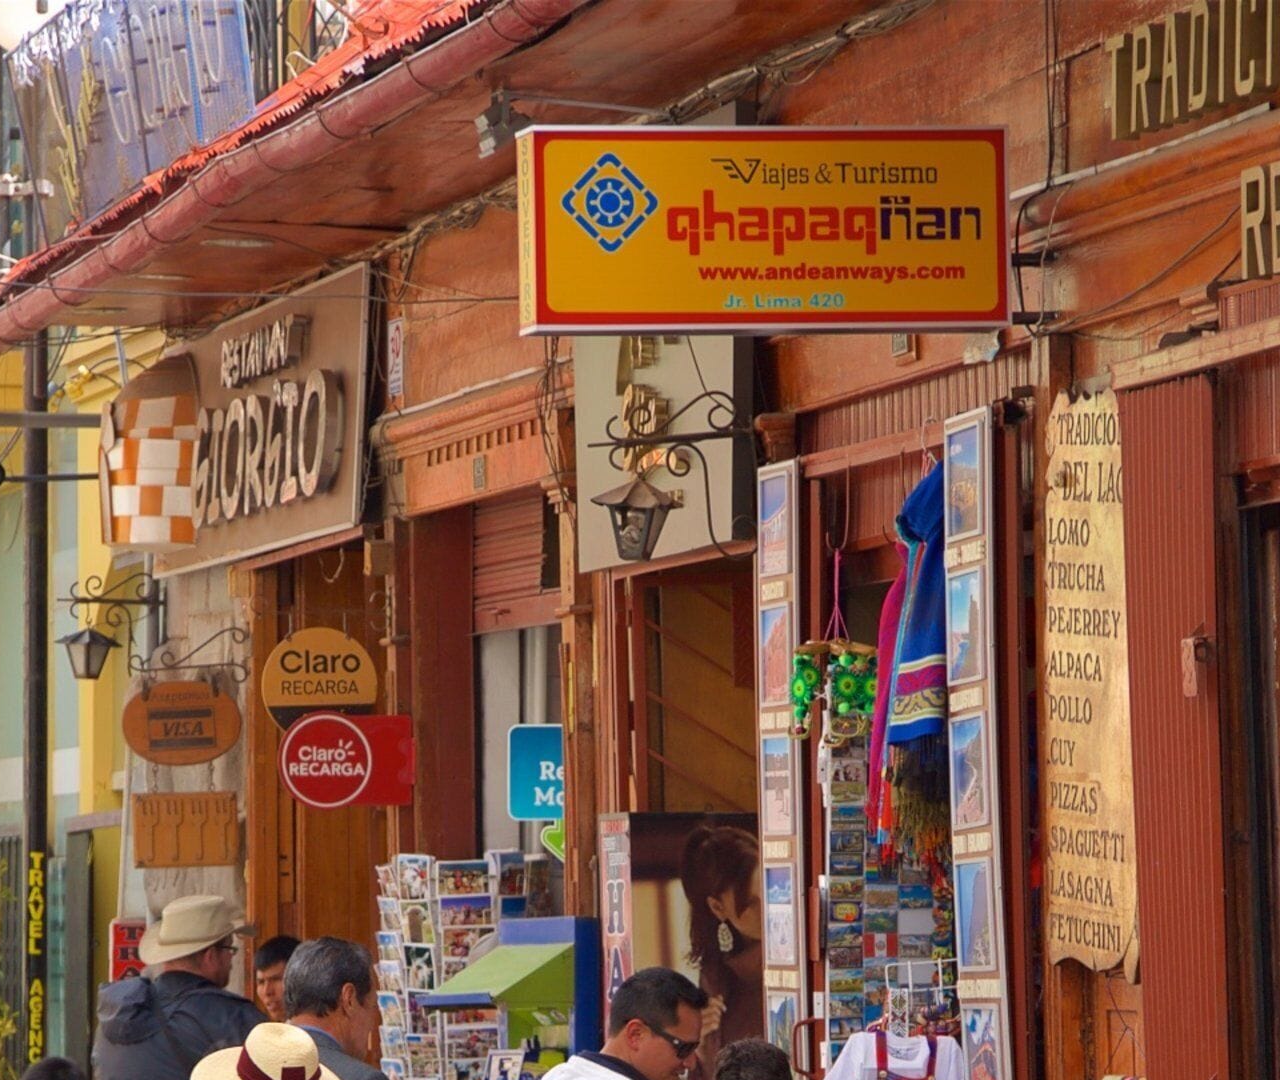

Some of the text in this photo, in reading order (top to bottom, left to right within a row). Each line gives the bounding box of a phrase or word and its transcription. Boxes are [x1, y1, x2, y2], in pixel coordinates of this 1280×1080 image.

[711, 157, 938, 191] Viajes & Turismo
[521, 137, 533, 322] SOUVENIRS
[698, 263, 966, 284] www.andeanways.com
[723, 292, 845, 309] Jr. Lima 420
[1057, 412, 1121, 446] TRADICIO
[1062, 461, 1093, 502] DEL
[1048, 517, 1091, 548] LOMO
[1048, 562, 1105, 592] TRUCHA
[1048, 606, 1121, 640] PEJERREY
[279, 650, 361, 675] Claro
[1048, 652, 1102, 682] ALPACA
[280, 678, 360, 697] RECARGA
[1049, 695, 1093, 725] POLLO
[163, 721, 205, 737] VISA
[297, 745, 347, 763] Claro
[1050, 737, 1076, 767] CUY
[288, 762, 366, 777] RECARGA
[1050, 782, 1098, 815] PIZZAS
[1050, 826, 1126, 863] SPAGUETTI
[27, 850, 45, 956] TRAVEL
[1050, 874, 1113, 909] LASAGNA
[1049, 913, 1122, 953] FETUCHINI
